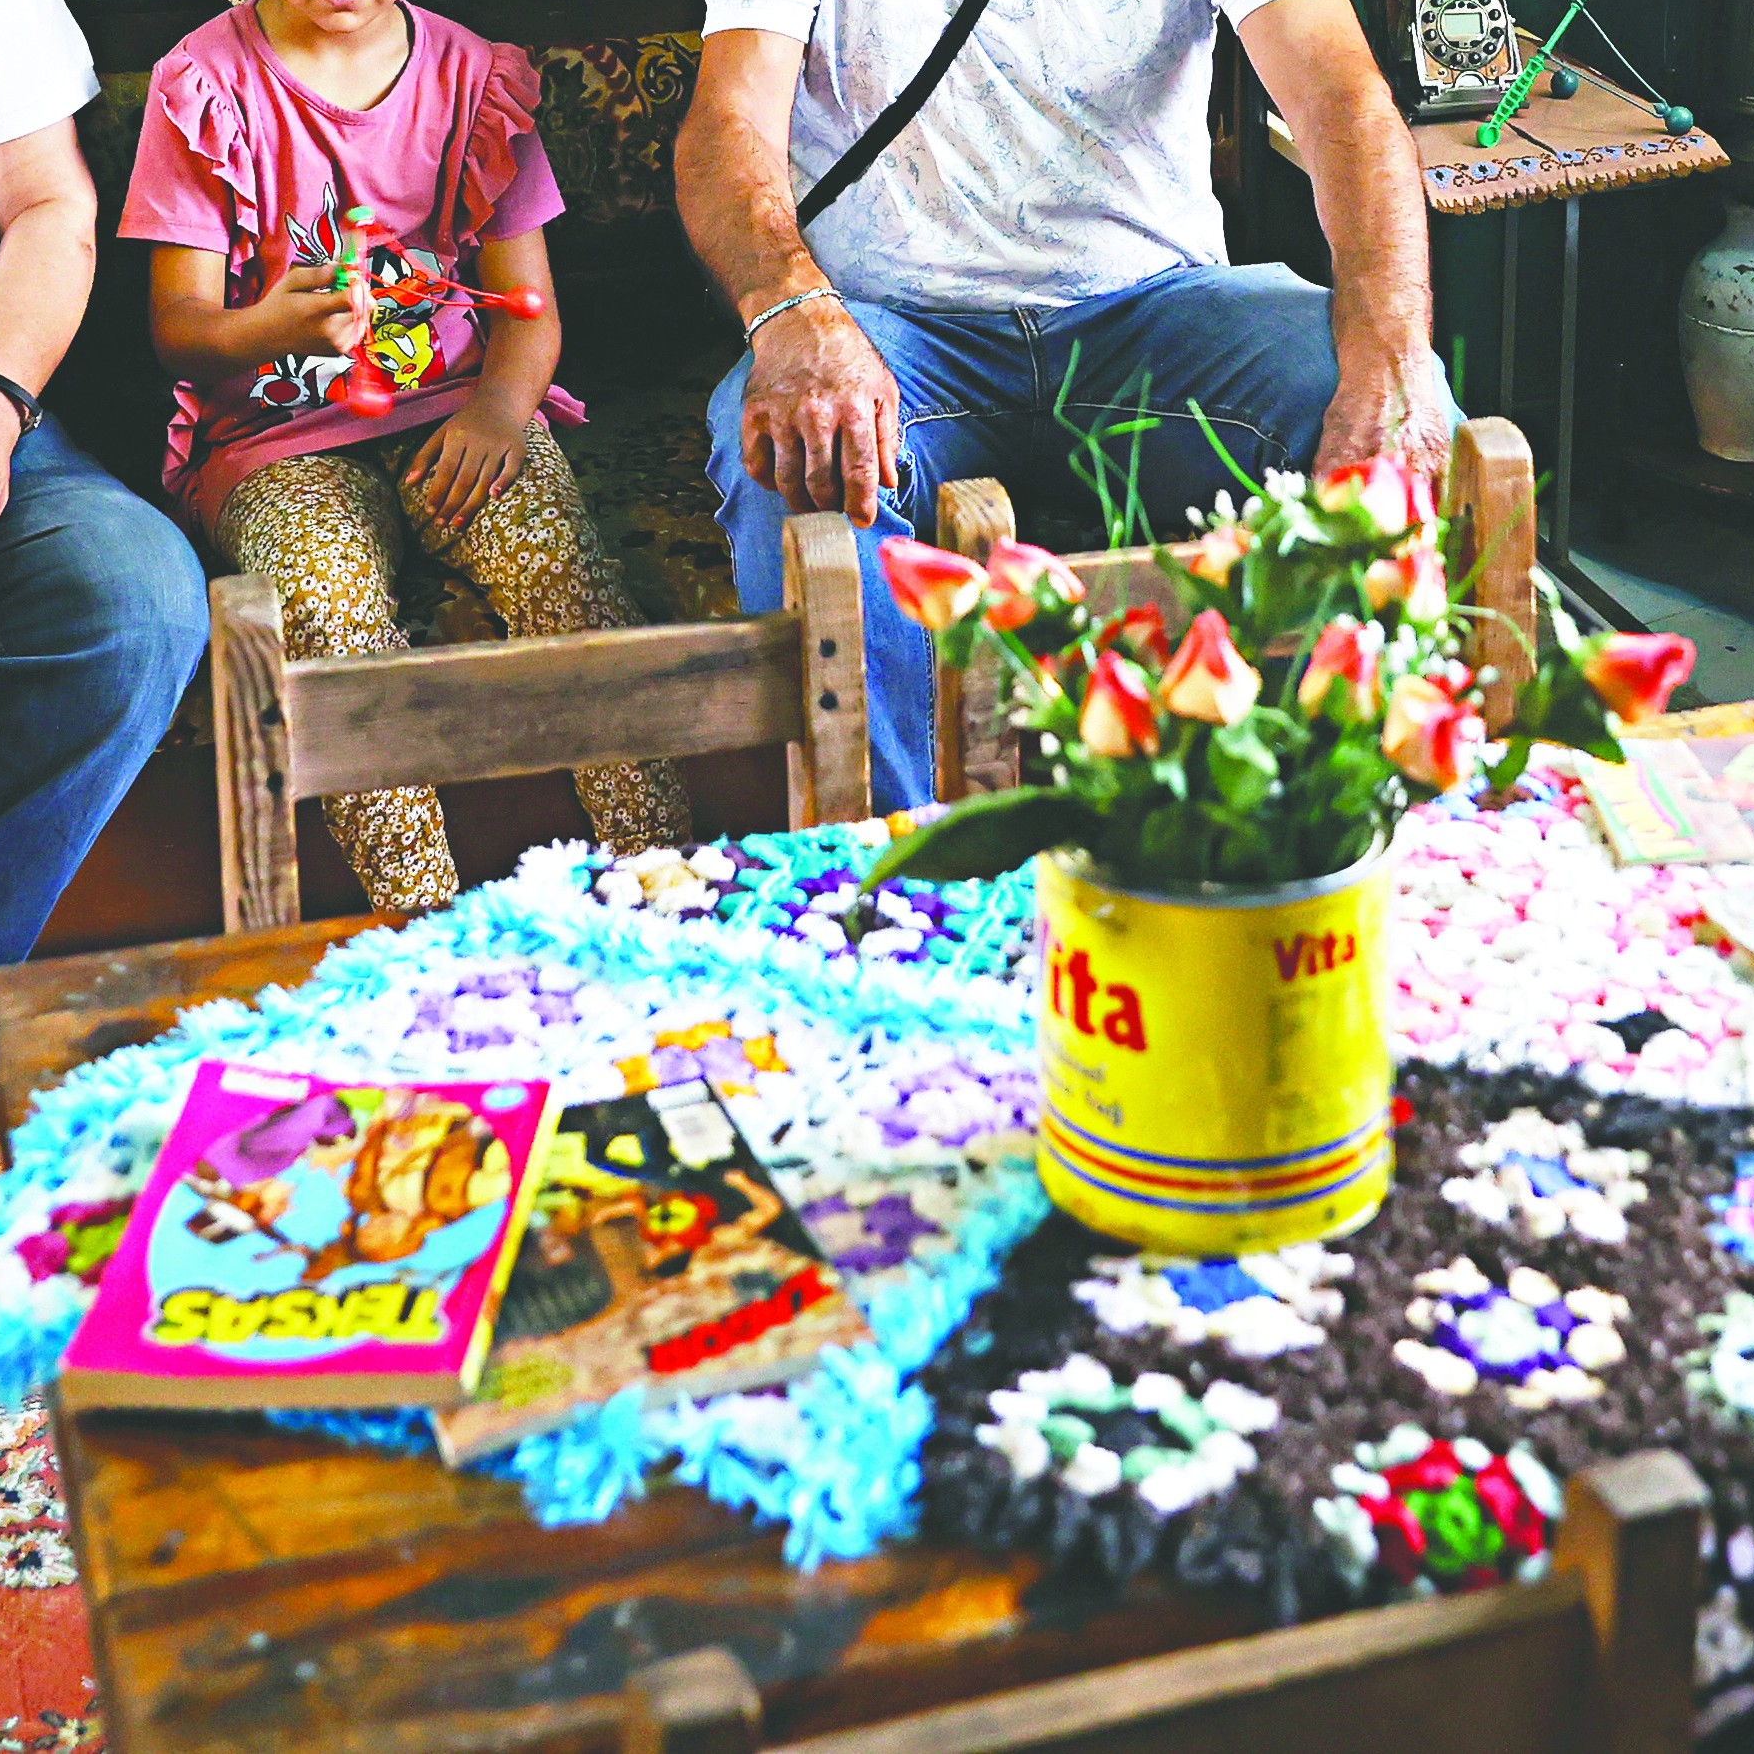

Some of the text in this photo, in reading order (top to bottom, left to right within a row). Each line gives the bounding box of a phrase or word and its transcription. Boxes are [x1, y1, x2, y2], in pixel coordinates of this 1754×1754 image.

[1273, 928, 1357, 982] Vita
[1042, 931, 1148, 1053] ita
[153, 1283, 444, 1343] TEKSAS
